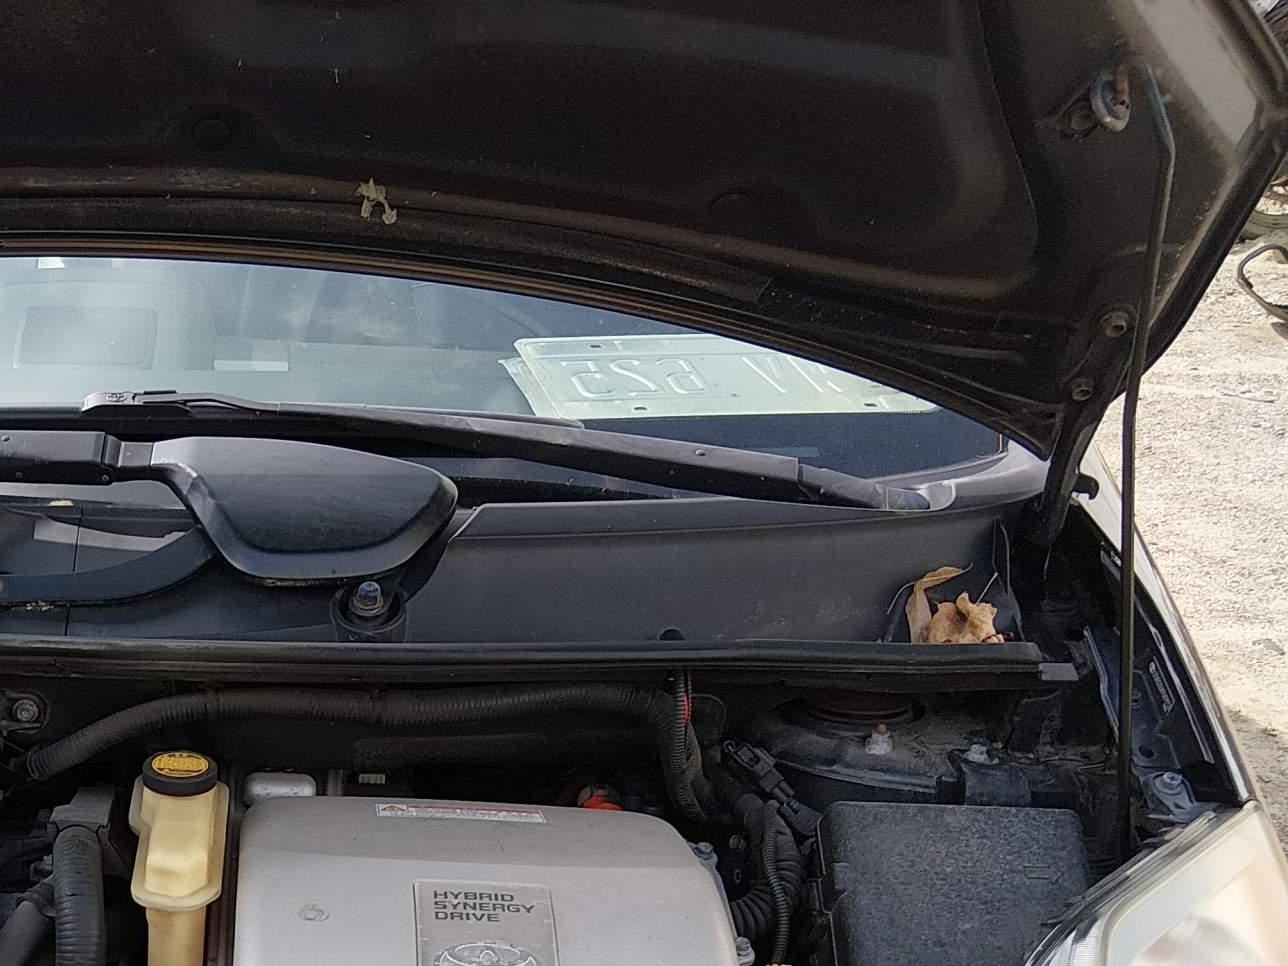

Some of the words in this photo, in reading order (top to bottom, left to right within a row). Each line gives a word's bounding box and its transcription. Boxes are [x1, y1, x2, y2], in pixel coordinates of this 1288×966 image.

[433, 890, 515, 902] HYBRID
[433, 901, 536, 914] SYNERGY
[434, 911, 501, 923] DRIVE
